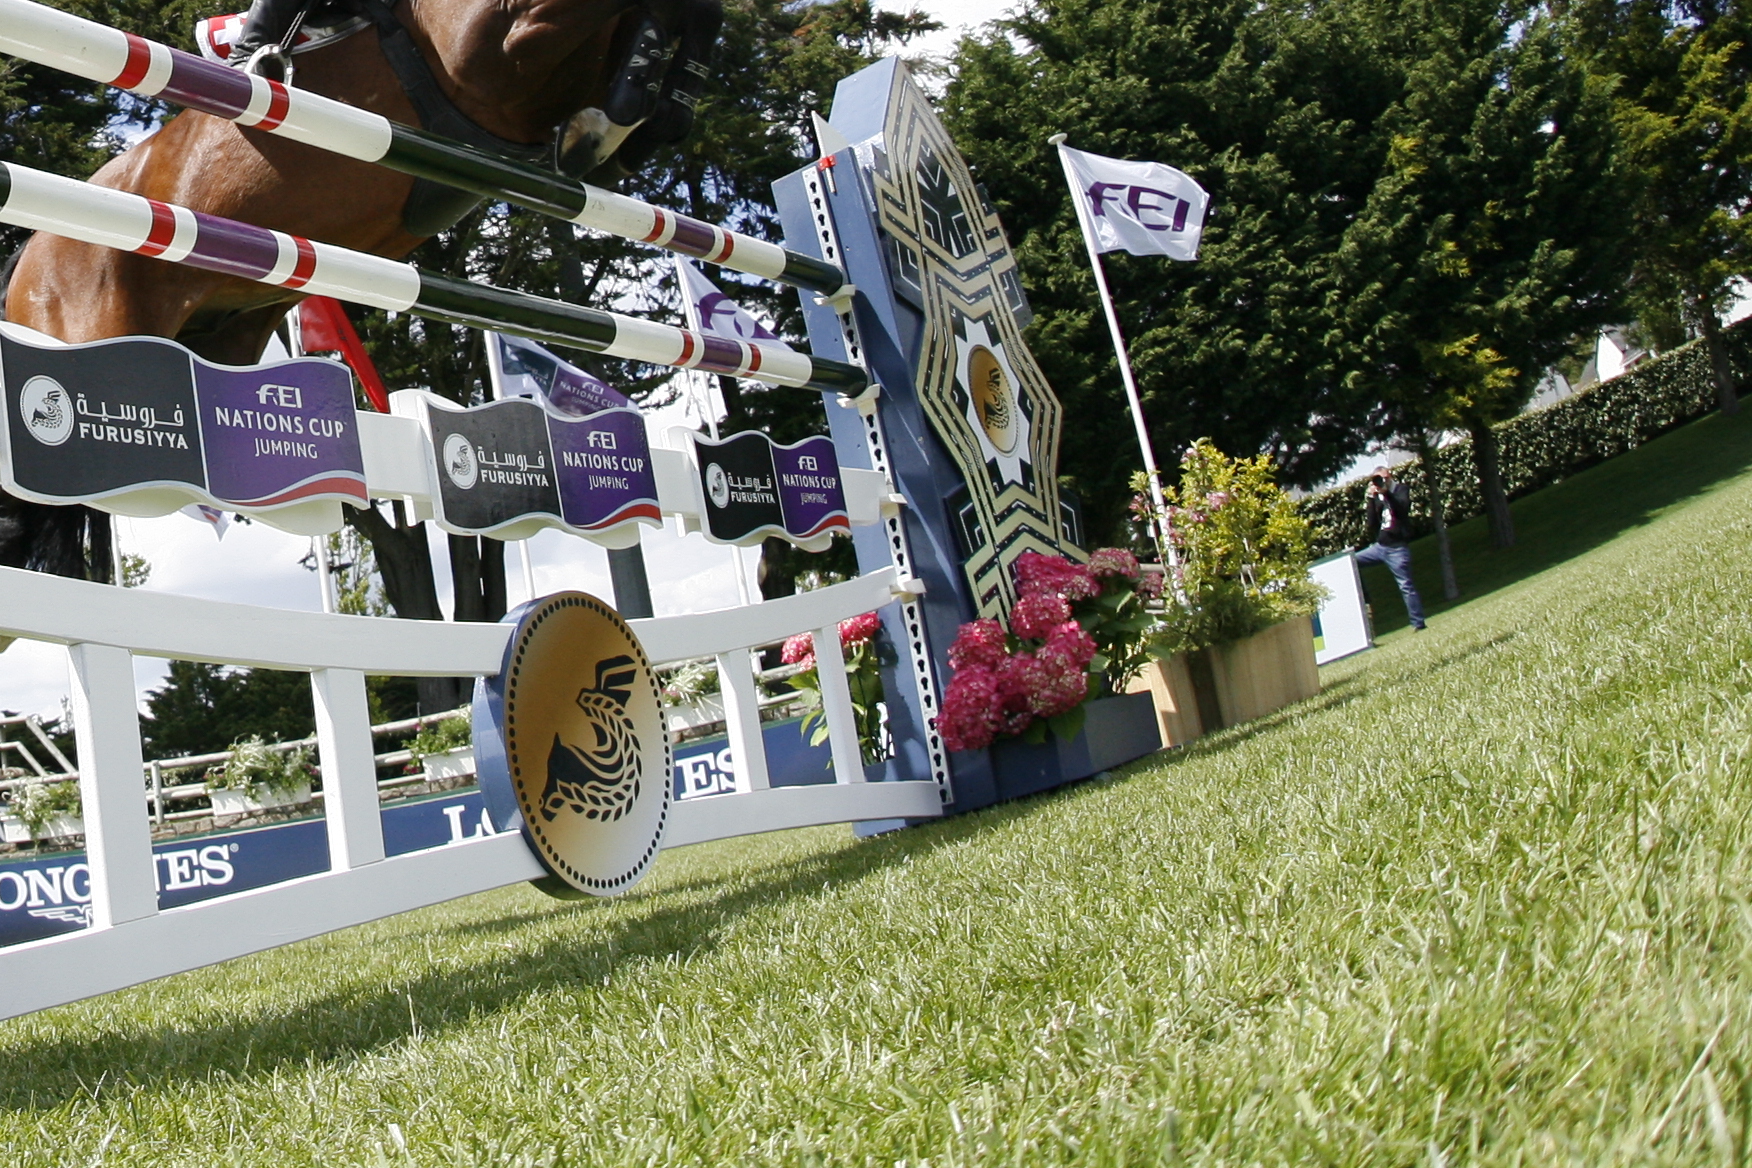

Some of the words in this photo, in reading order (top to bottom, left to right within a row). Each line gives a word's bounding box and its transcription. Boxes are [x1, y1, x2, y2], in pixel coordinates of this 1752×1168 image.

[1085, 181, 1190, 231] FEI
[255, 383, 303, 409] FEI
[559, 380, 599, 405] NATIONS
[76, 392, 184, 429] فروسية
[215, 406, 303, 434] NATIONS
[78, 422, 189, 450] FURUSIYYA
[586, 430, 617, 450] FEI
[254, 438, 318, 459] JUMPING
[477, 445, 545, 472] فروسية
[563, 451, 619, 471] NATIONS
[621, 457, 644, 473] CUP
[797, 455, 818, 471] FEI
[480, 469, 549, 488] FURUSIYYA
[589, 474, 629, 490] JUMPING
[782, 473, 819, 489] NATIONS
[820, 476, 837, 490] CUP
[730, 491, 776, 504] FURUSIYYA
